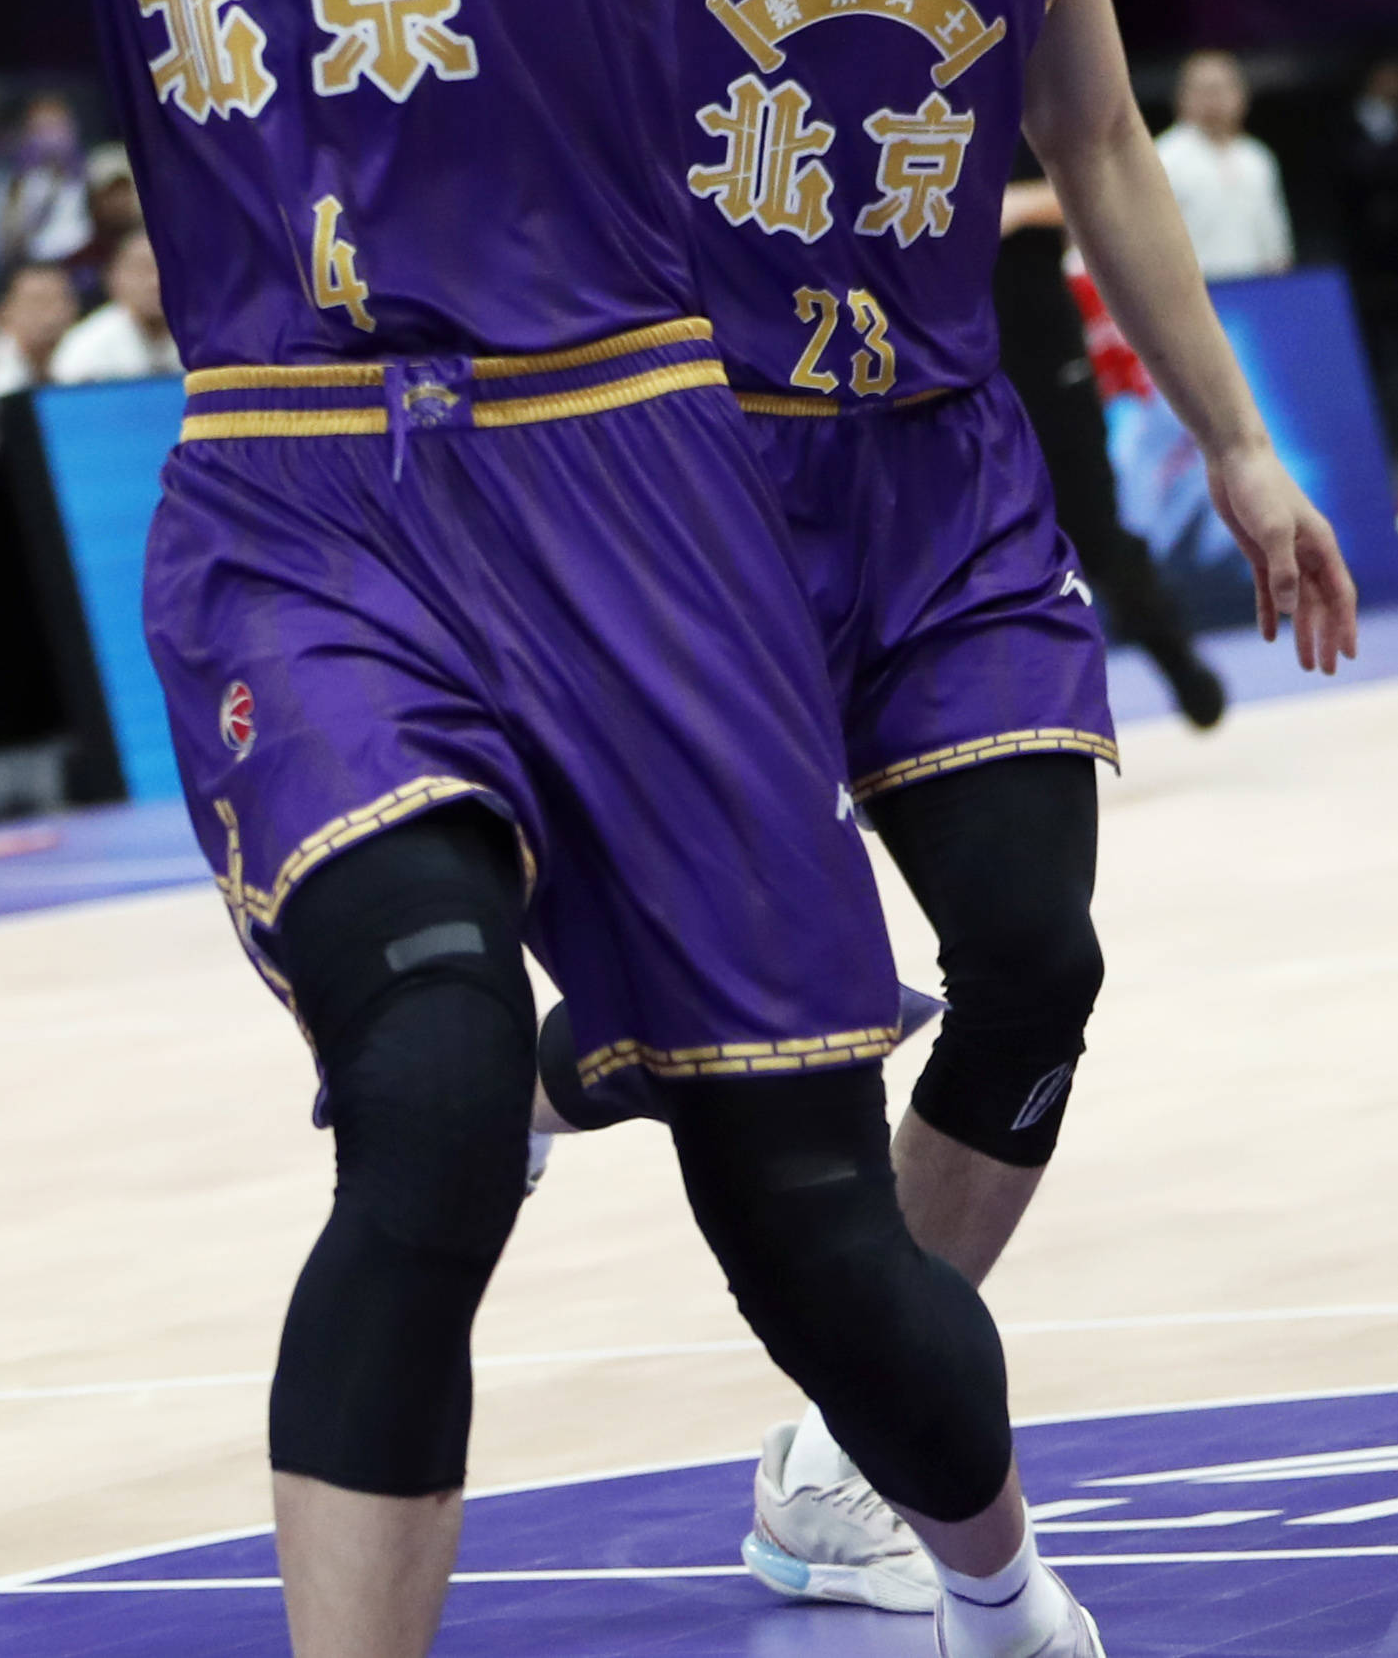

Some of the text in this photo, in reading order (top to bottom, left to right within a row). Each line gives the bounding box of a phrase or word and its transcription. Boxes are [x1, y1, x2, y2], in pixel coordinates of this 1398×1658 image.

[687, 71, 975, 249] 北京
[312, 193, 376, 333] 4
[789, 287, 897, 398] 23
